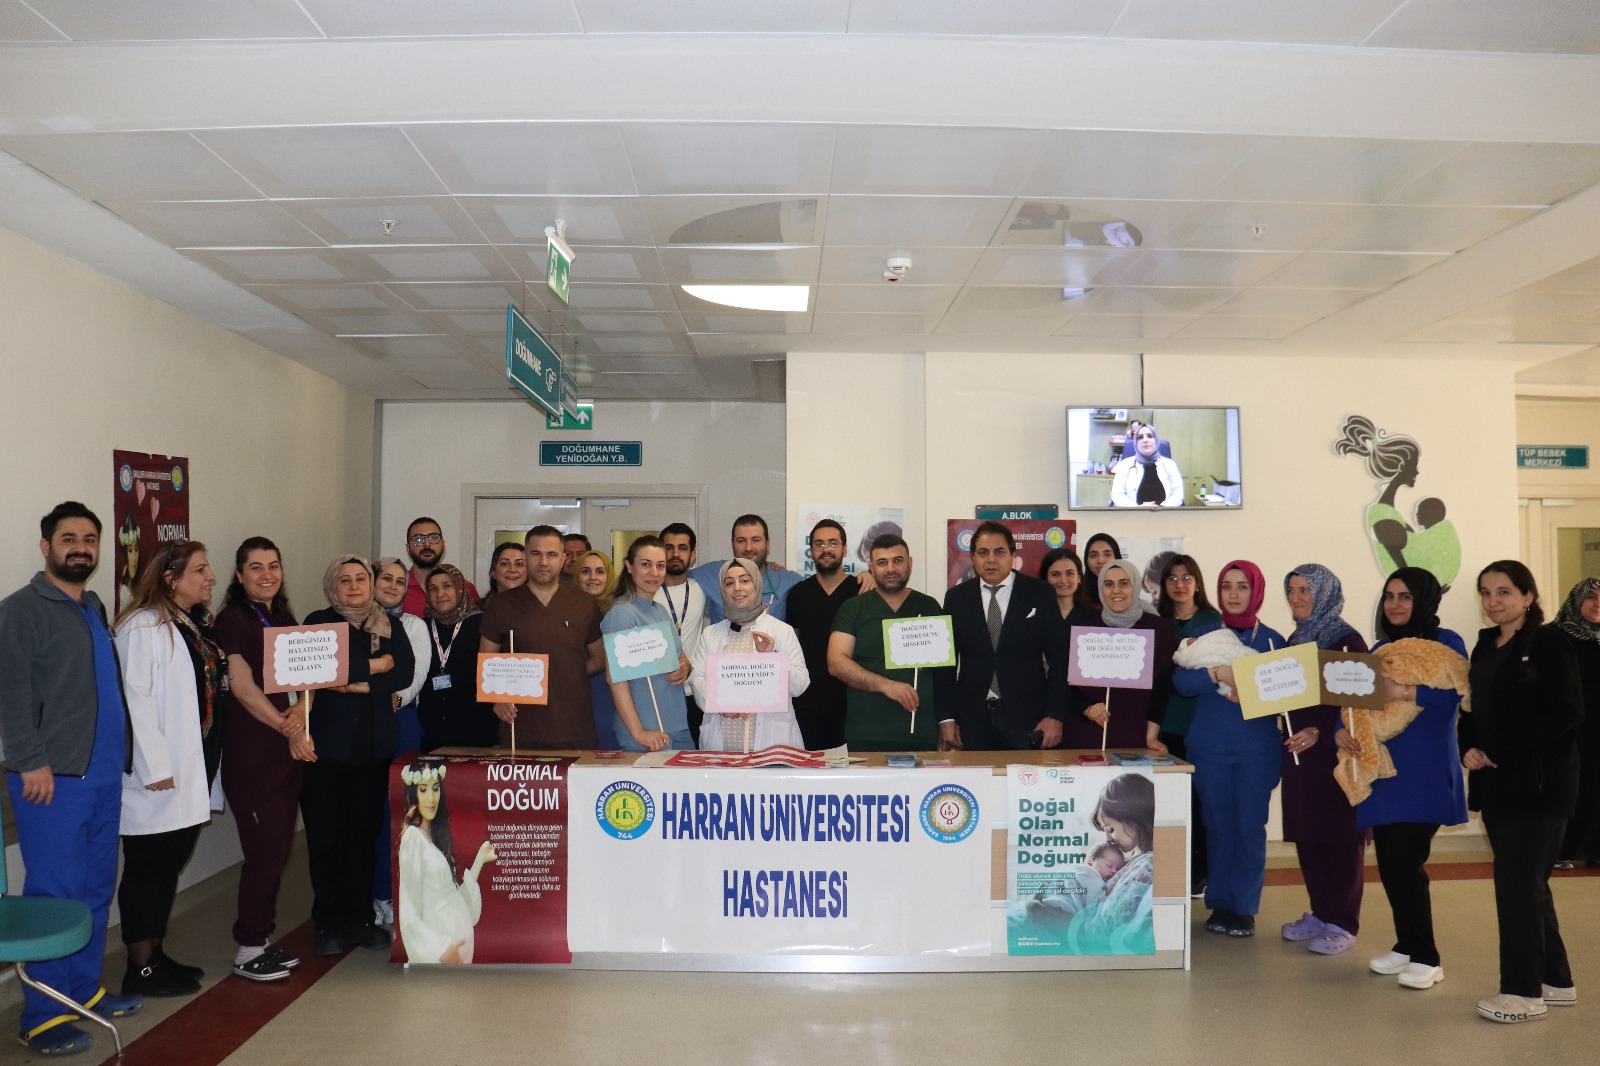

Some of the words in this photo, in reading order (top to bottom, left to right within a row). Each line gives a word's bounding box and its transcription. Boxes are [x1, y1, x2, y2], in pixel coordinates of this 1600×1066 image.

[516, 338, 541, 376] DOĞUMHANE
[562, 444, 620, 453] DOĞUMHANE
[1519, 448, 1536, 457] TÜP
[1537, 449, 1566, 457] BEBEK
[556, 454, 608, 462] YENİDOĞAN
[1524, 458, 1561, 466] MERKEZİ
[1002, 512, 1032, 520] A.BLOK
[157, 525, 188, 541] NORMAL
[901, 624, 933, 632] DOĞUMUN
[289, 664, 322, 672] SAĞLAYIN
[487, 764, 563, 781] NORMAL
[487, 783, 560, 811] DOĞUM
[597, 786, 615, 820] HARRAN
[1019, 798, 1075, 816] Doğal
[662, 792, 755, 841] HARRAN
[760, 794, 910, 843] ÜNİVERSİTESİ
[1019, 816, 1064, 830] Olan
[1018, 832, 1089, 847] Normal
[1017, 850, 1087, 868] Doğum
[723, 869, 848, 919] HASTANESİ
[1494, 1011, 1528, 1021] crocs
